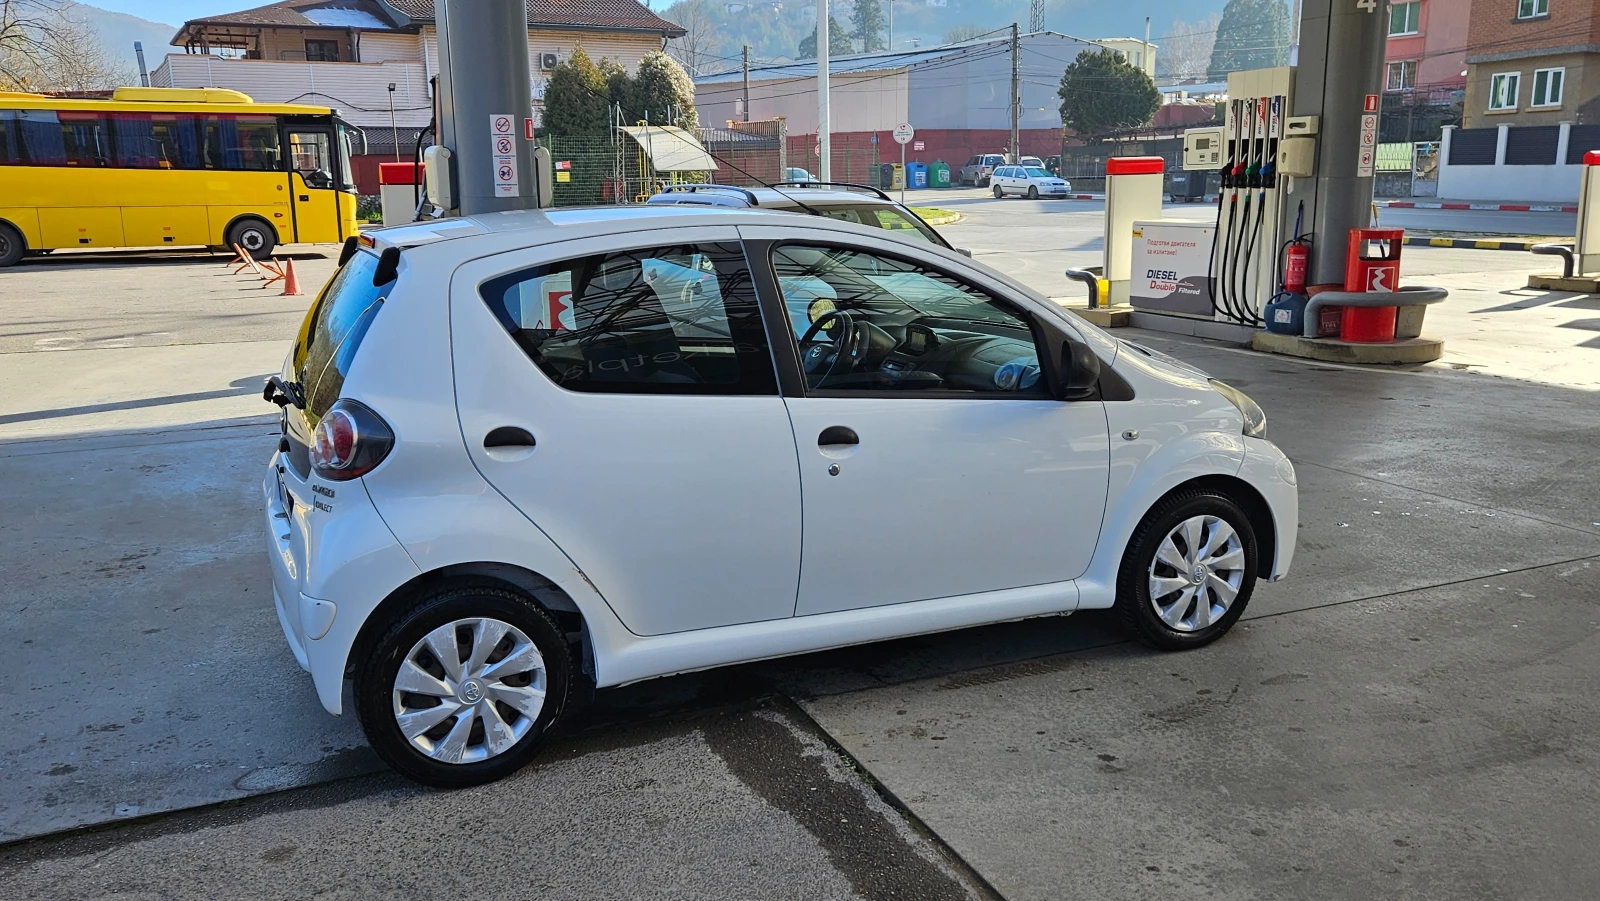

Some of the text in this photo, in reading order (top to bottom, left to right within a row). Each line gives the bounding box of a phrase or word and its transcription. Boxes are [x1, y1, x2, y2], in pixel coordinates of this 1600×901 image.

[1356, 0, 1376, 13] 4
[1147, 269, 1178, 281] DIESEL
[1150, 280, 1200, 295] Double Filtered
